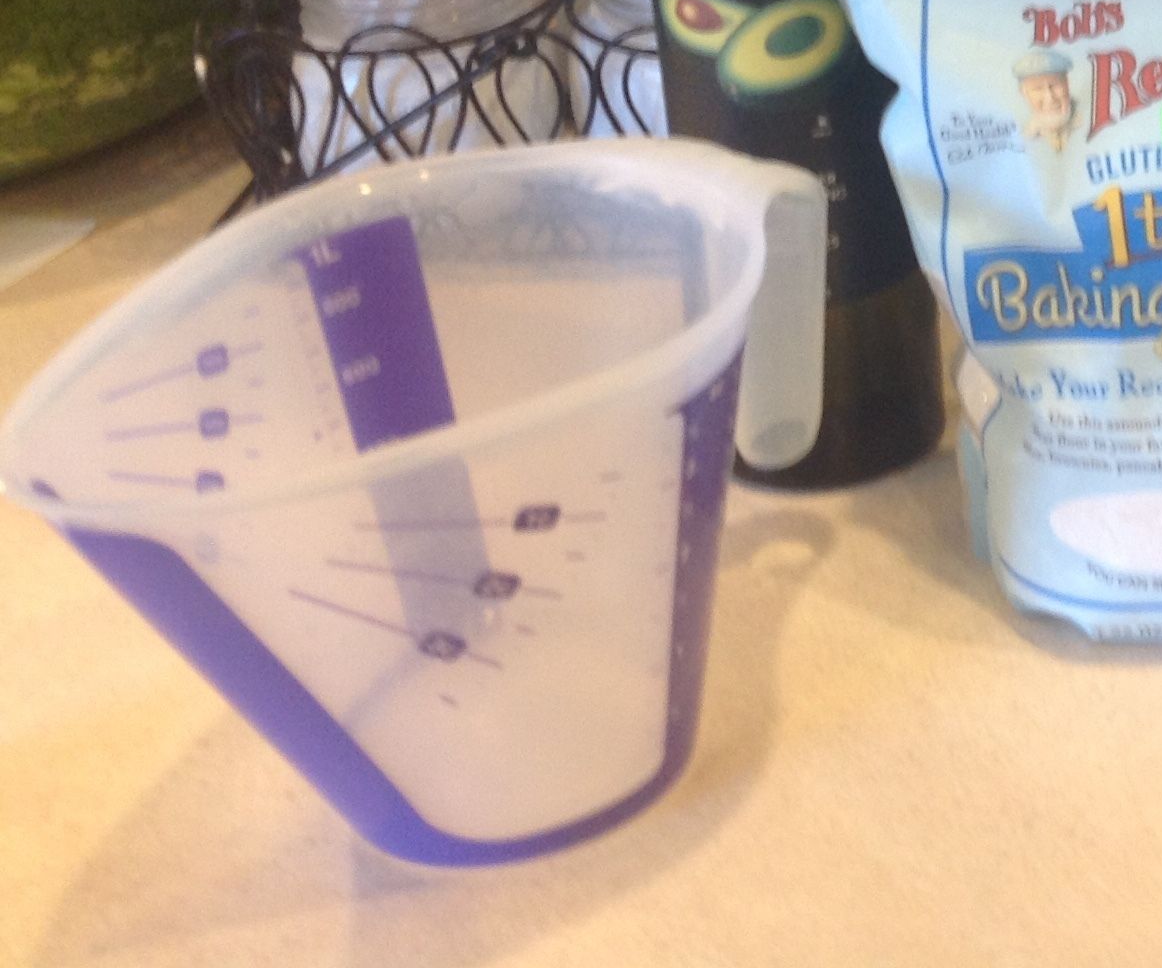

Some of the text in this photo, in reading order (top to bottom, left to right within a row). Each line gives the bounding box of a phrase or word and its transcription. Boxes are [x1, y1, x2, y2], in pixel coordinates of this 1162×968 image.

[1022, 0, 1125, 47] Bob's
[1093, 184, 1130, 268] 1
[1049, 368, 1109, 401] Your
